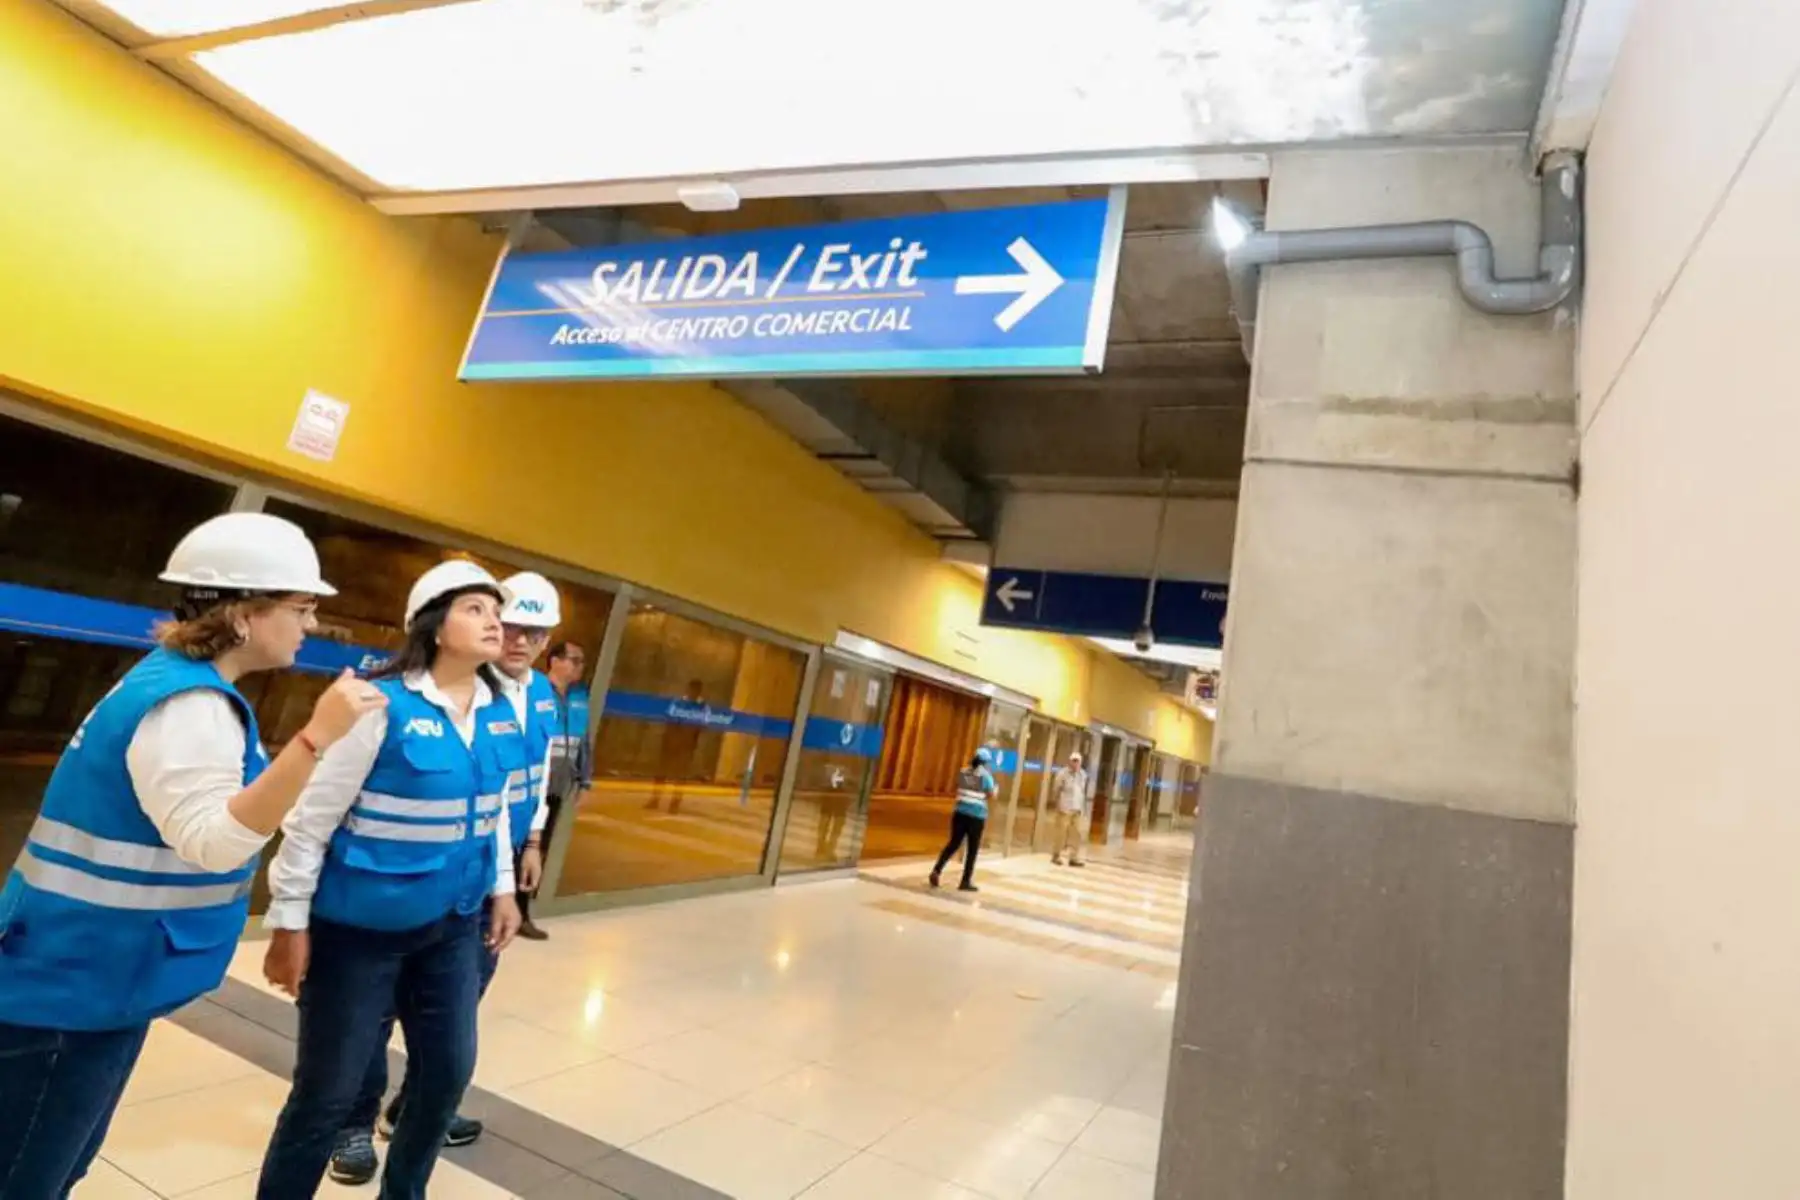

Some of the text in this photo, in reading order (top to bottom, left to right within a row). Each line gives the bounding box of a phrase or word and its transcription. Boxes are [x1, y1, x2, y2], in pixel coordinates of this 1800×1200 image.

[586, 237, 927, 304] SALIDA / Exit
[549, 324, 621, 345] Acceso
[651, 314, 749, 341] CENTRO
[753, 306, 912, 337] COMERCIAL
